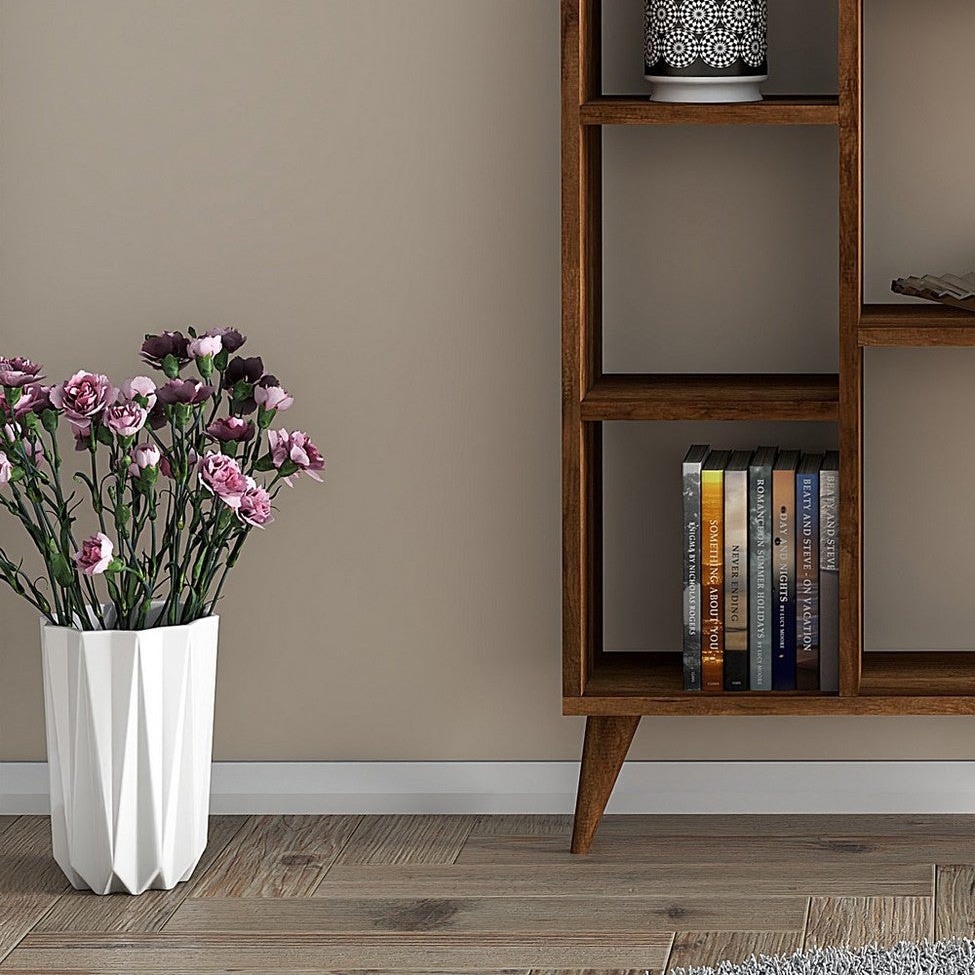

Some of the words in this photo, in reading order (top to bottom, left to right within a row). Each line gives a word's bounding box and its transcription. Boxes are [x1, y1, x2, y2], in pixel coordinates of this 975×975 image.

[803, 479, 811, 510] BEATY
[826, 477, 834, 511] BEATY
[780, 513, 788, 534] DAY
[803, 514, 811, 535] AND
[826, 514, 835, 536] AND
[689, 554, 696, 563] BY
[709, 520, 718, 583] SOMETHING
[731, 545, 739, 578] NEVER
[780, 539, 788, 561] AND
[803, 539, 811, 570] STEVE
[826, 539, 835, 570] STEVE
[756, 550, 764, 589] SUMMER
[780, 563, 788, 602] NIGHTS
[803, 579, 811, 593] ON
[710, 587, 718, 622] ABOUT
[731, 582, 739, 622] ENDING
[756, 592, 765, 639] HOLIDAYS
[710, 626, 719, 650] YOU
[803, 598, 811, 651] VACATION
